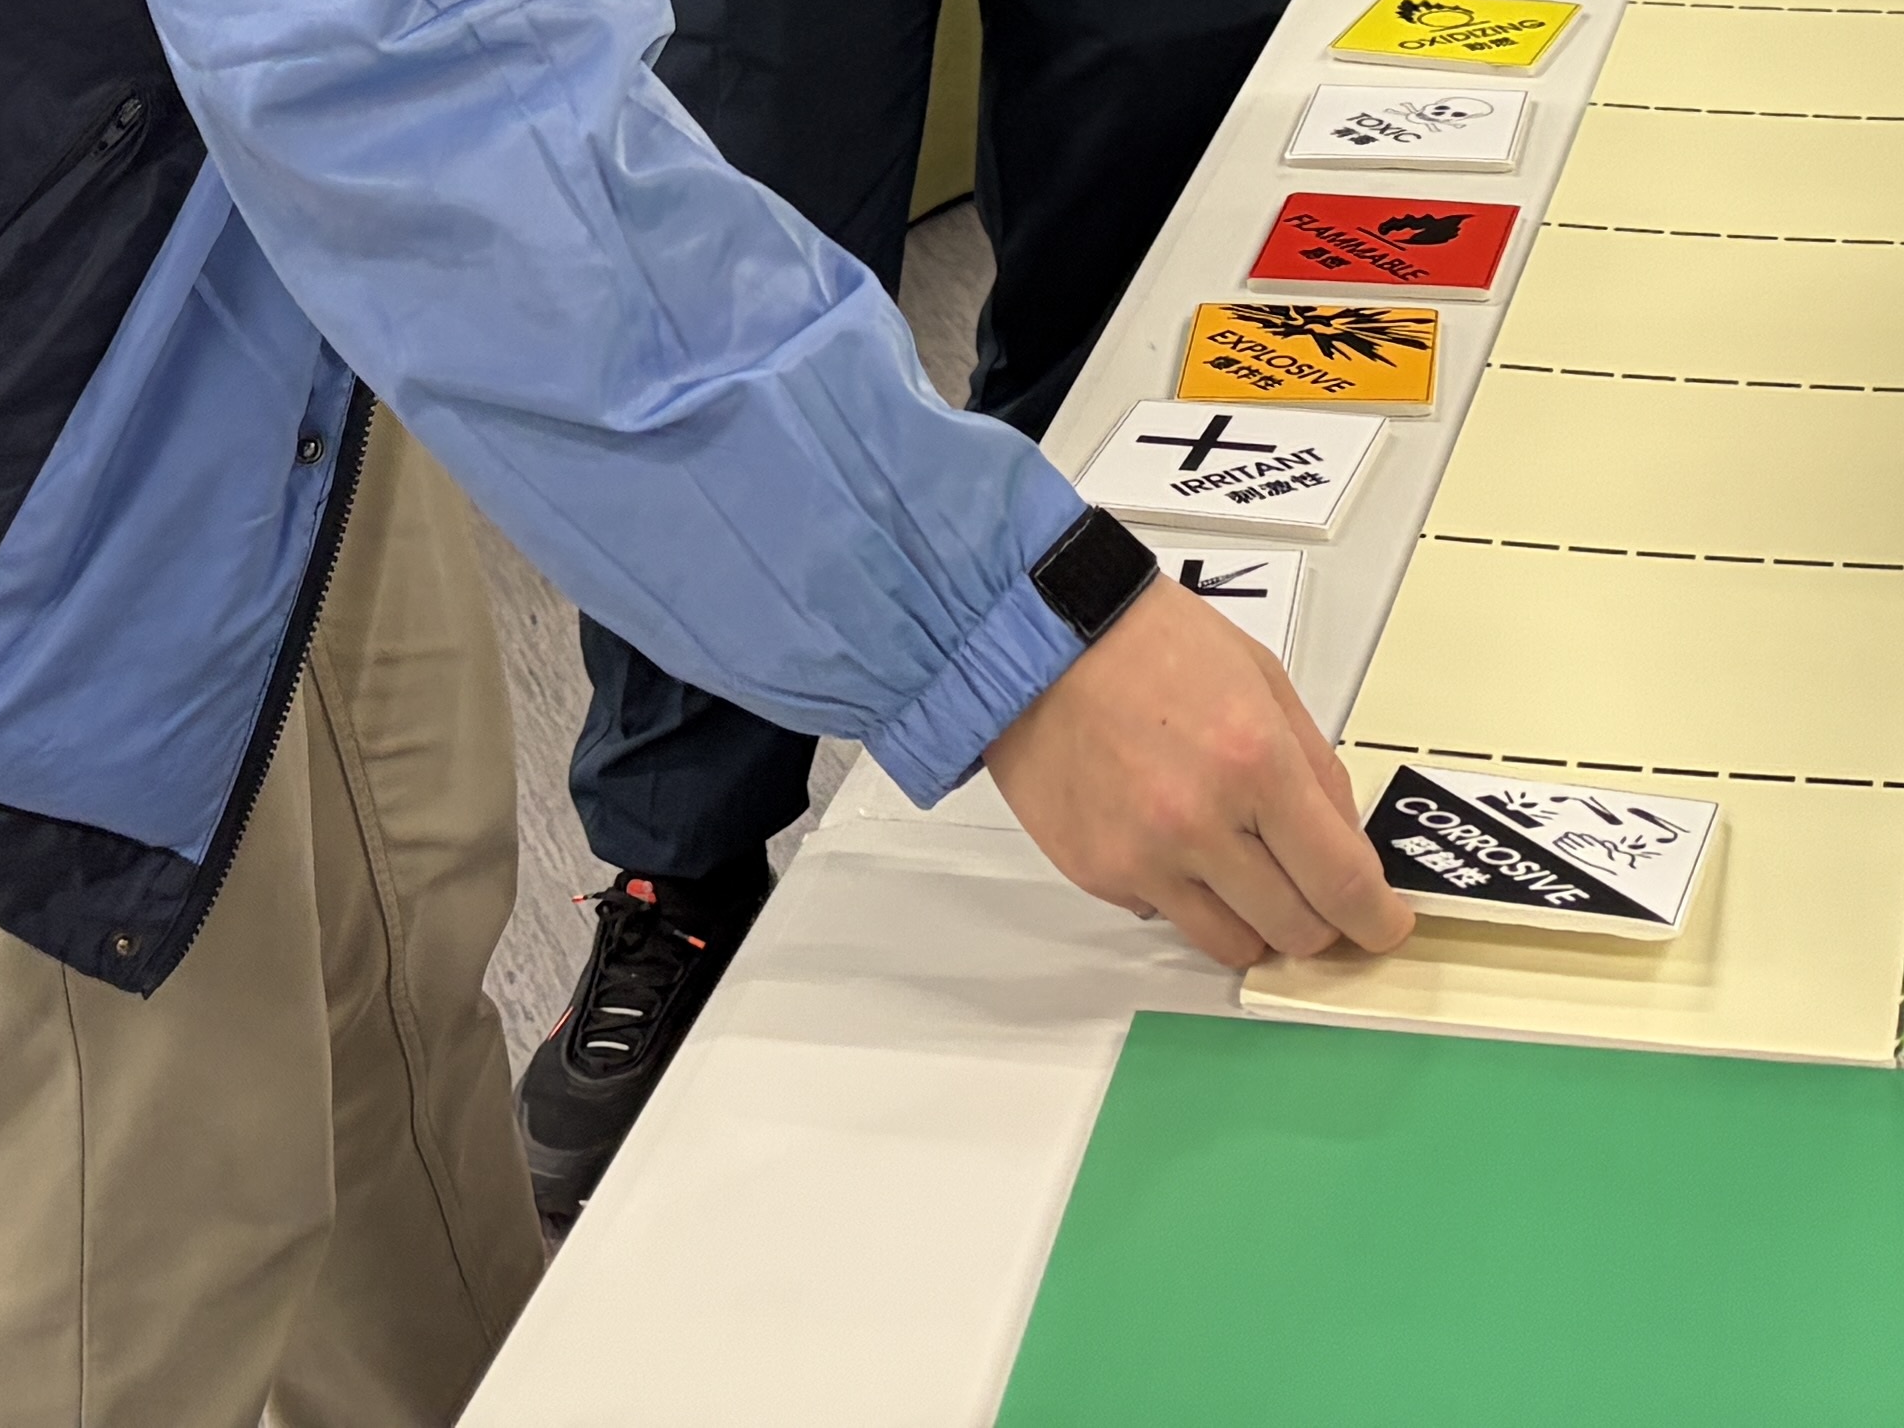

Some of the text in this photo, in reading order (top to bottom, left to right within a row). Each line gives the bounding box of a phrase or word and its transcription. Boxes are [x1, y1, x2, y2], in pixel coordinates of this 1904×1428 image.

[1398, 19, 1546, 51] OXIDIZING
[1346, 112, 1422, 144] TOXIC
[1283, 213, 1430, 282] FLAMMABLE
[1203, 355, 1285, 392] 爆炸性
[1207, 329, 1356, 394] EXPLOSIVE
[1169, 447, 1324, 497] IRRITANT
[1225, 470, 1331, 505] 刺激性
[1390, 835, 1493, 890] 腐蝕性
[1395, 796, 1591, 907] CORROSIVE
